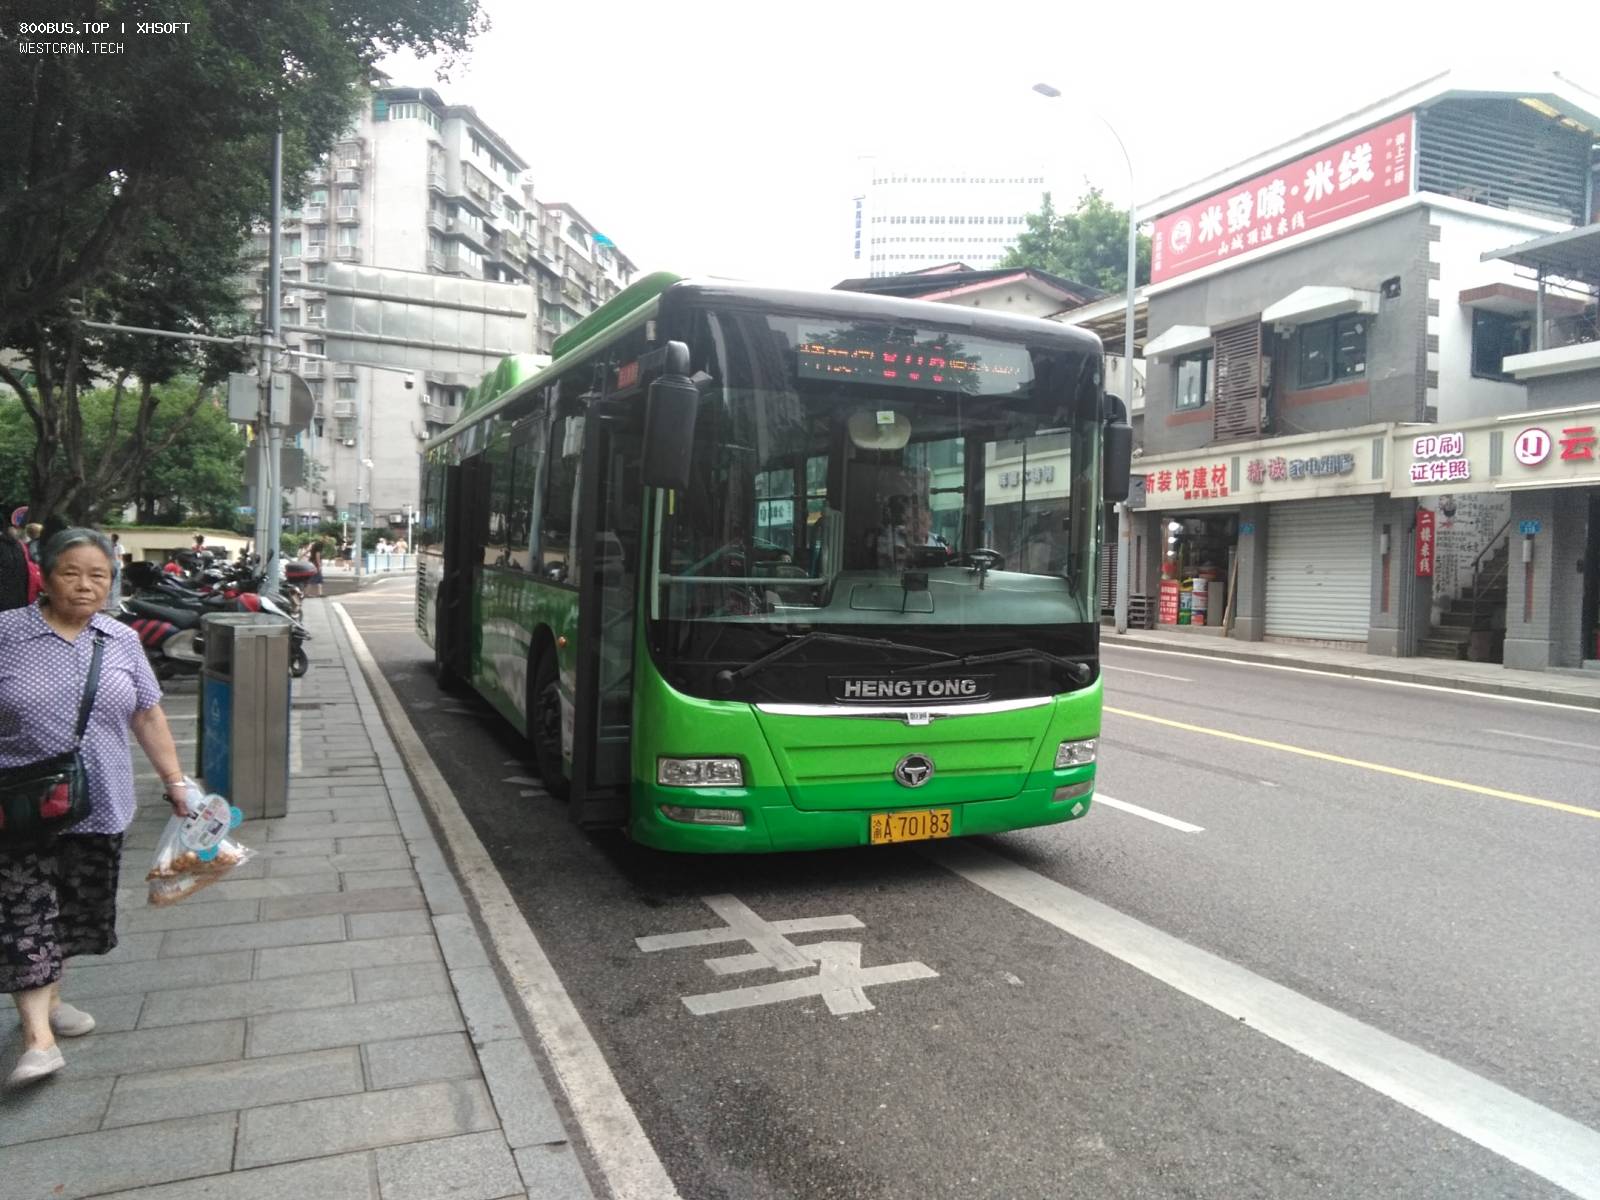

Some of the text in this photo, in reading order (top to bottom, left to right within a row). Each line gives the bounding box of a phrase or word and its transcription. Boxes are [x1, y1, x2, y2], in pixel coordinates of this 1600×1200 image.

[1414, 434, 1463, 456] 印刷
[1411, 460, 1469, 482] 证件照
[844, 679, 977, 698] HENGTONG
